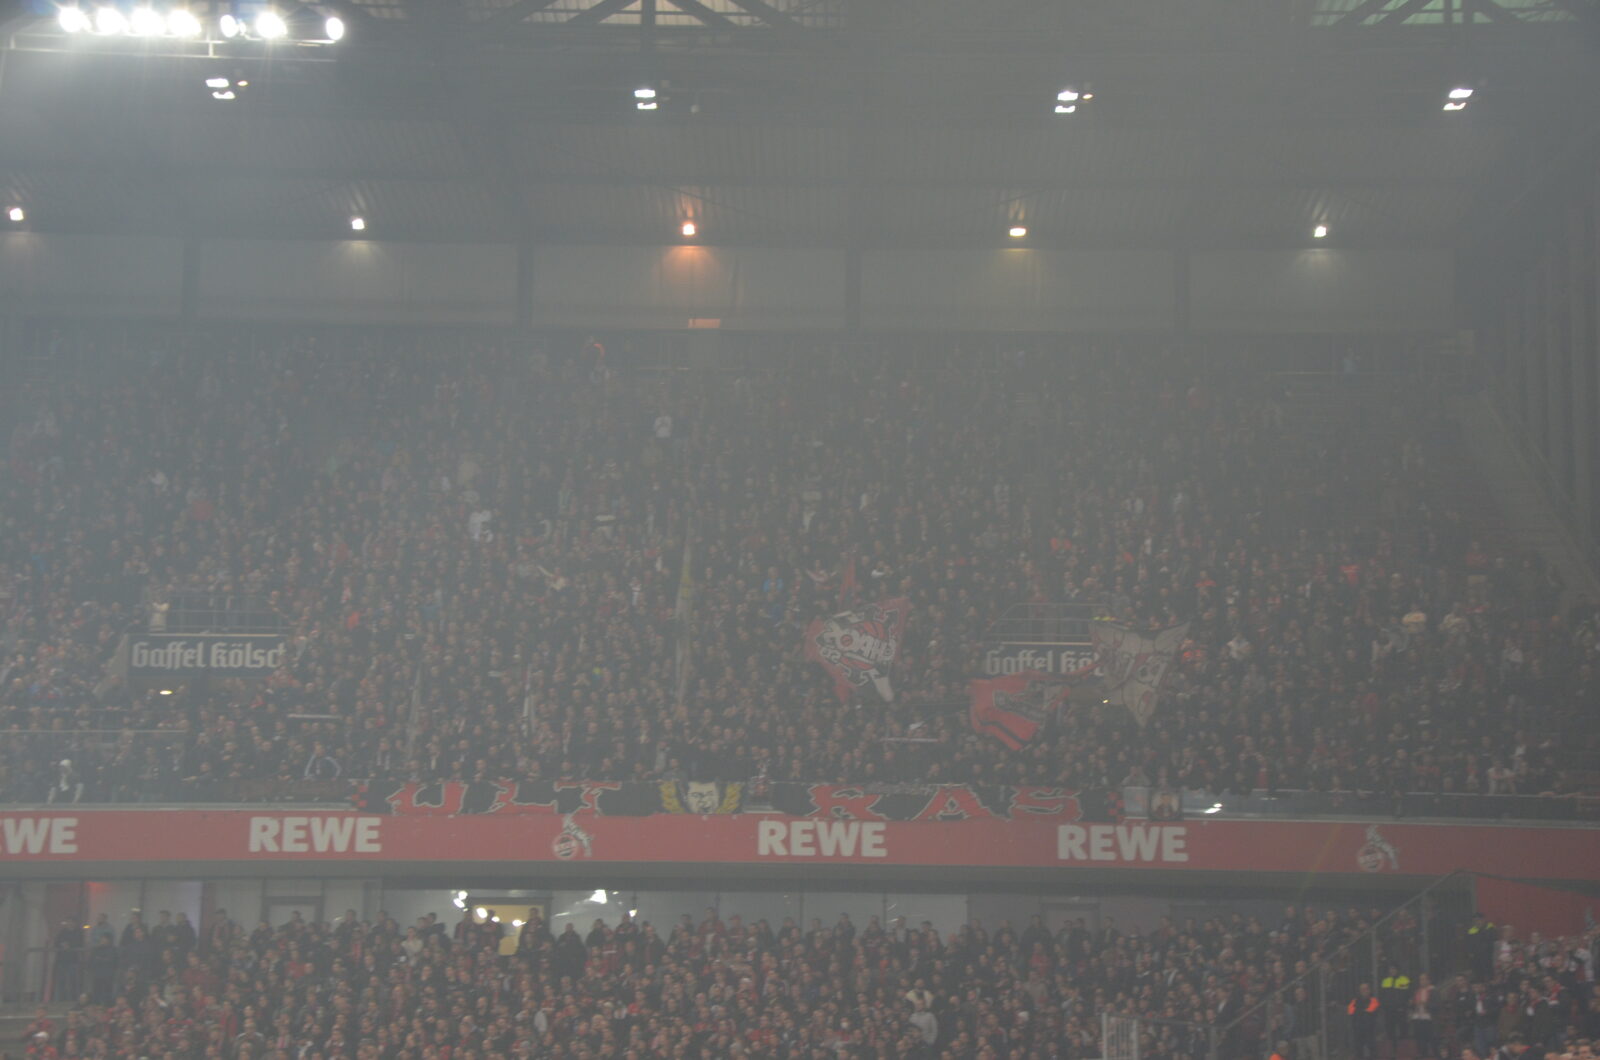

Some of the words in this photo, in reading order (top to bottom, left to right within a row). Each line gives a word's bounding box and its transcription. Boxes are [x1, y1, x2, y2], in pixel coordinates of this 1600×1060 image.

[131, 640, 206, 670] Gaffel
[985, 649, 1054, 675] Gaffel
[0, 817, 79, 854] WE
[248, 816, 383, 853] REWE
[757, 820, 889, 857] REWE
[1057, 824, 1190, 862] REWE
